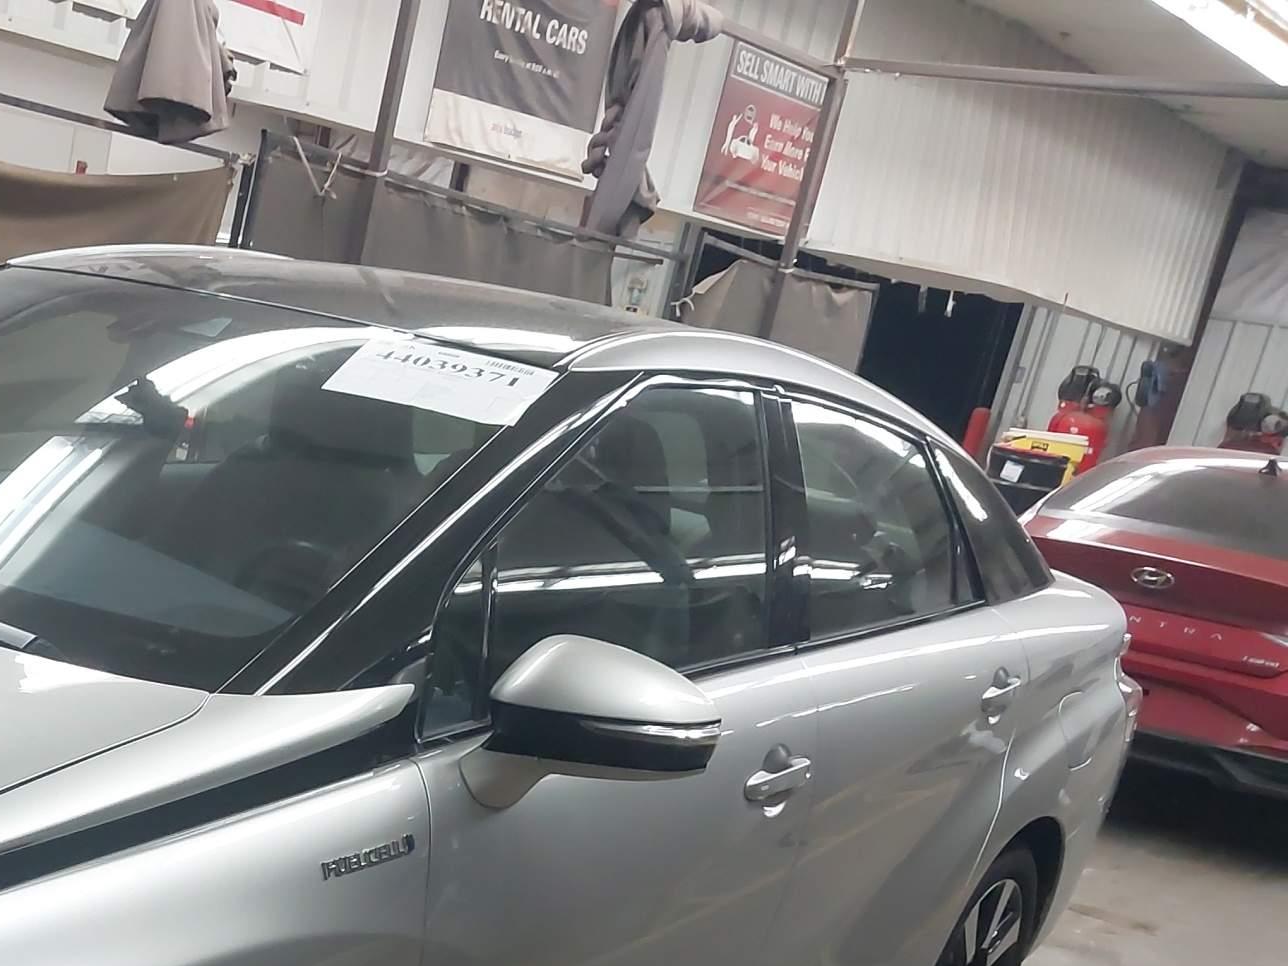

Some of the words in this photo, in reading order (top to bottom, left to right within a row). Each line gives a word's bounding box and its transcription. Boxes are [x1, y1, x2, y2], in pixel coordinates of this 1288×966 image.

[479, 0, 542, 40] RENTAL
[545, 19, 589, 55] CARS
[736, 50, 761, 80] SELL
[760, 60, 798, 93] SMART
[795, 74, 822, 105] WITH
[769, 113, 783, 131] We
[782, 118, 803, 140] Help
[764, 133, 785, 153] Earn
[782, 140, 804, 160] More
[778, 159, 805, 182] Vehicl
[375, 350, 520, 388] 44039371
